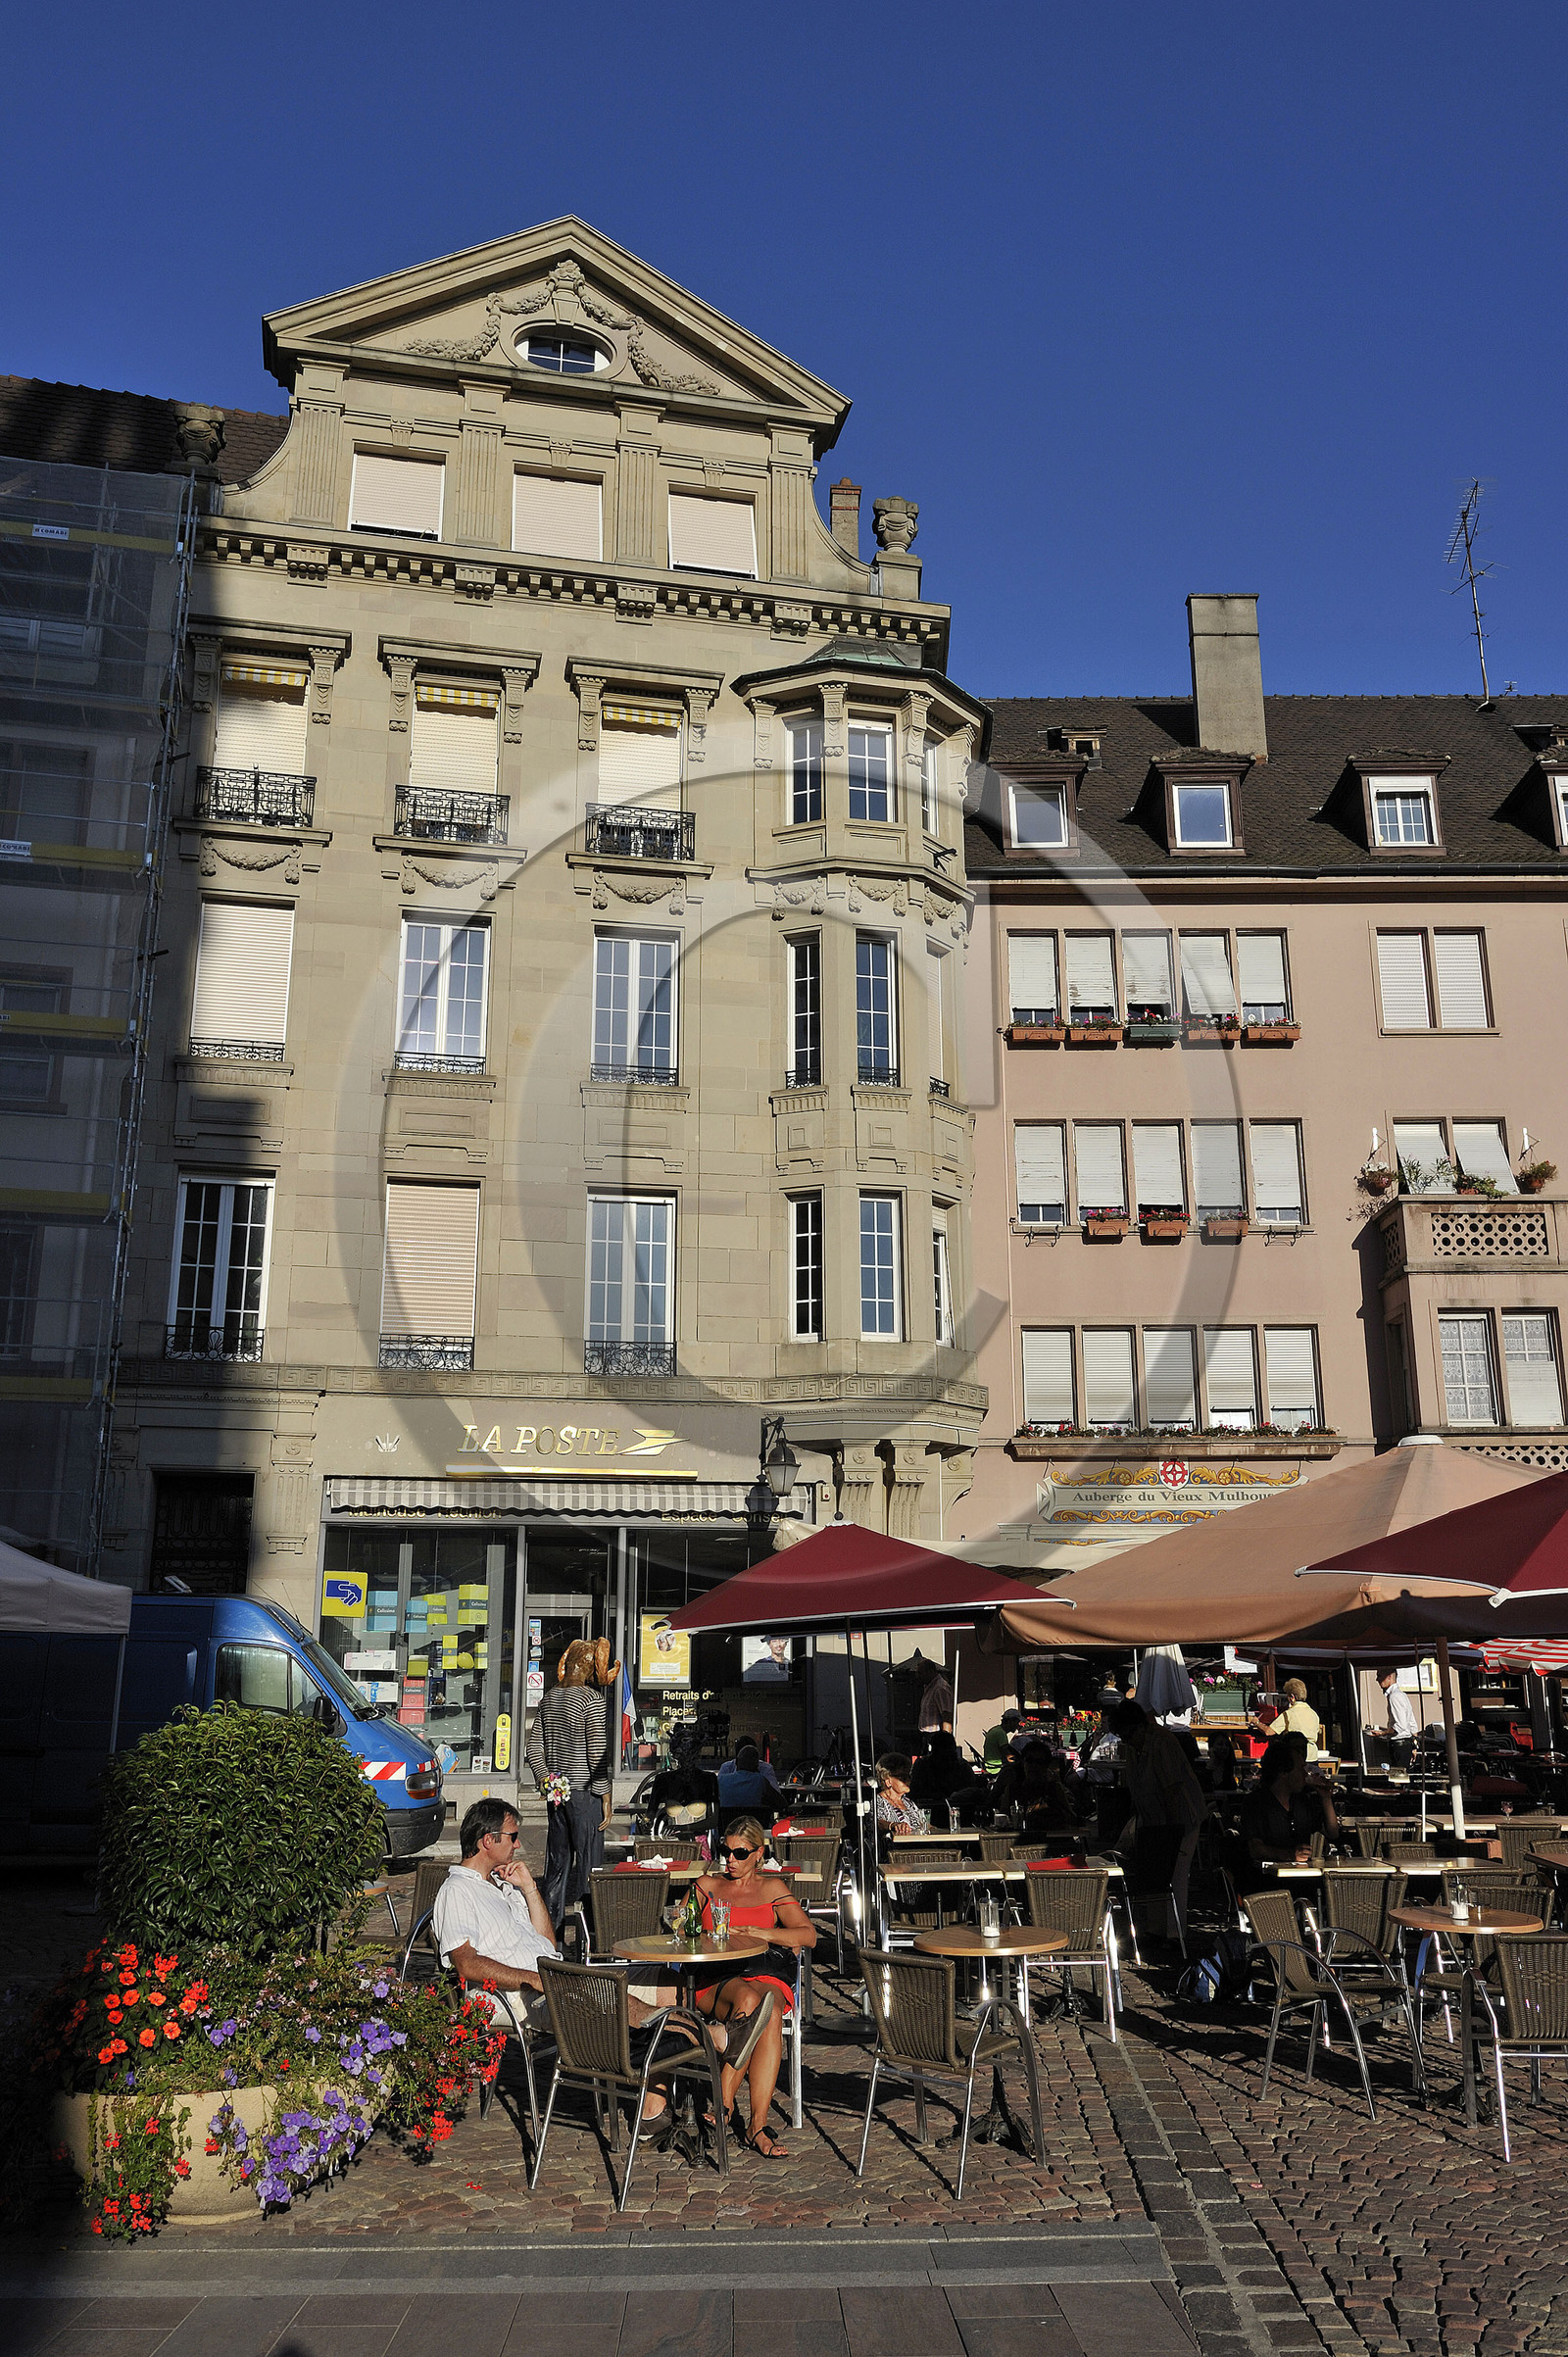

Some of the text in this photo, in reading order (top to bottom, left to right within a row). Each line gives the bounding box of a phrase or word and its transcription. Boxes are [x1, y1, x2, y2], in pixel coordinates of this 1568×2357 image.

[457, 1424, 620, 1456] LA POSTE
[1072, 1491, 1133, 1503] Auberge
[1138, 1491, 1155, 1501] du
[1159, 1491, 1203, 1501] Vieux
[661, 1510, 717, 1524] Espace
[662, 1690, 700, 1701] Retraits
